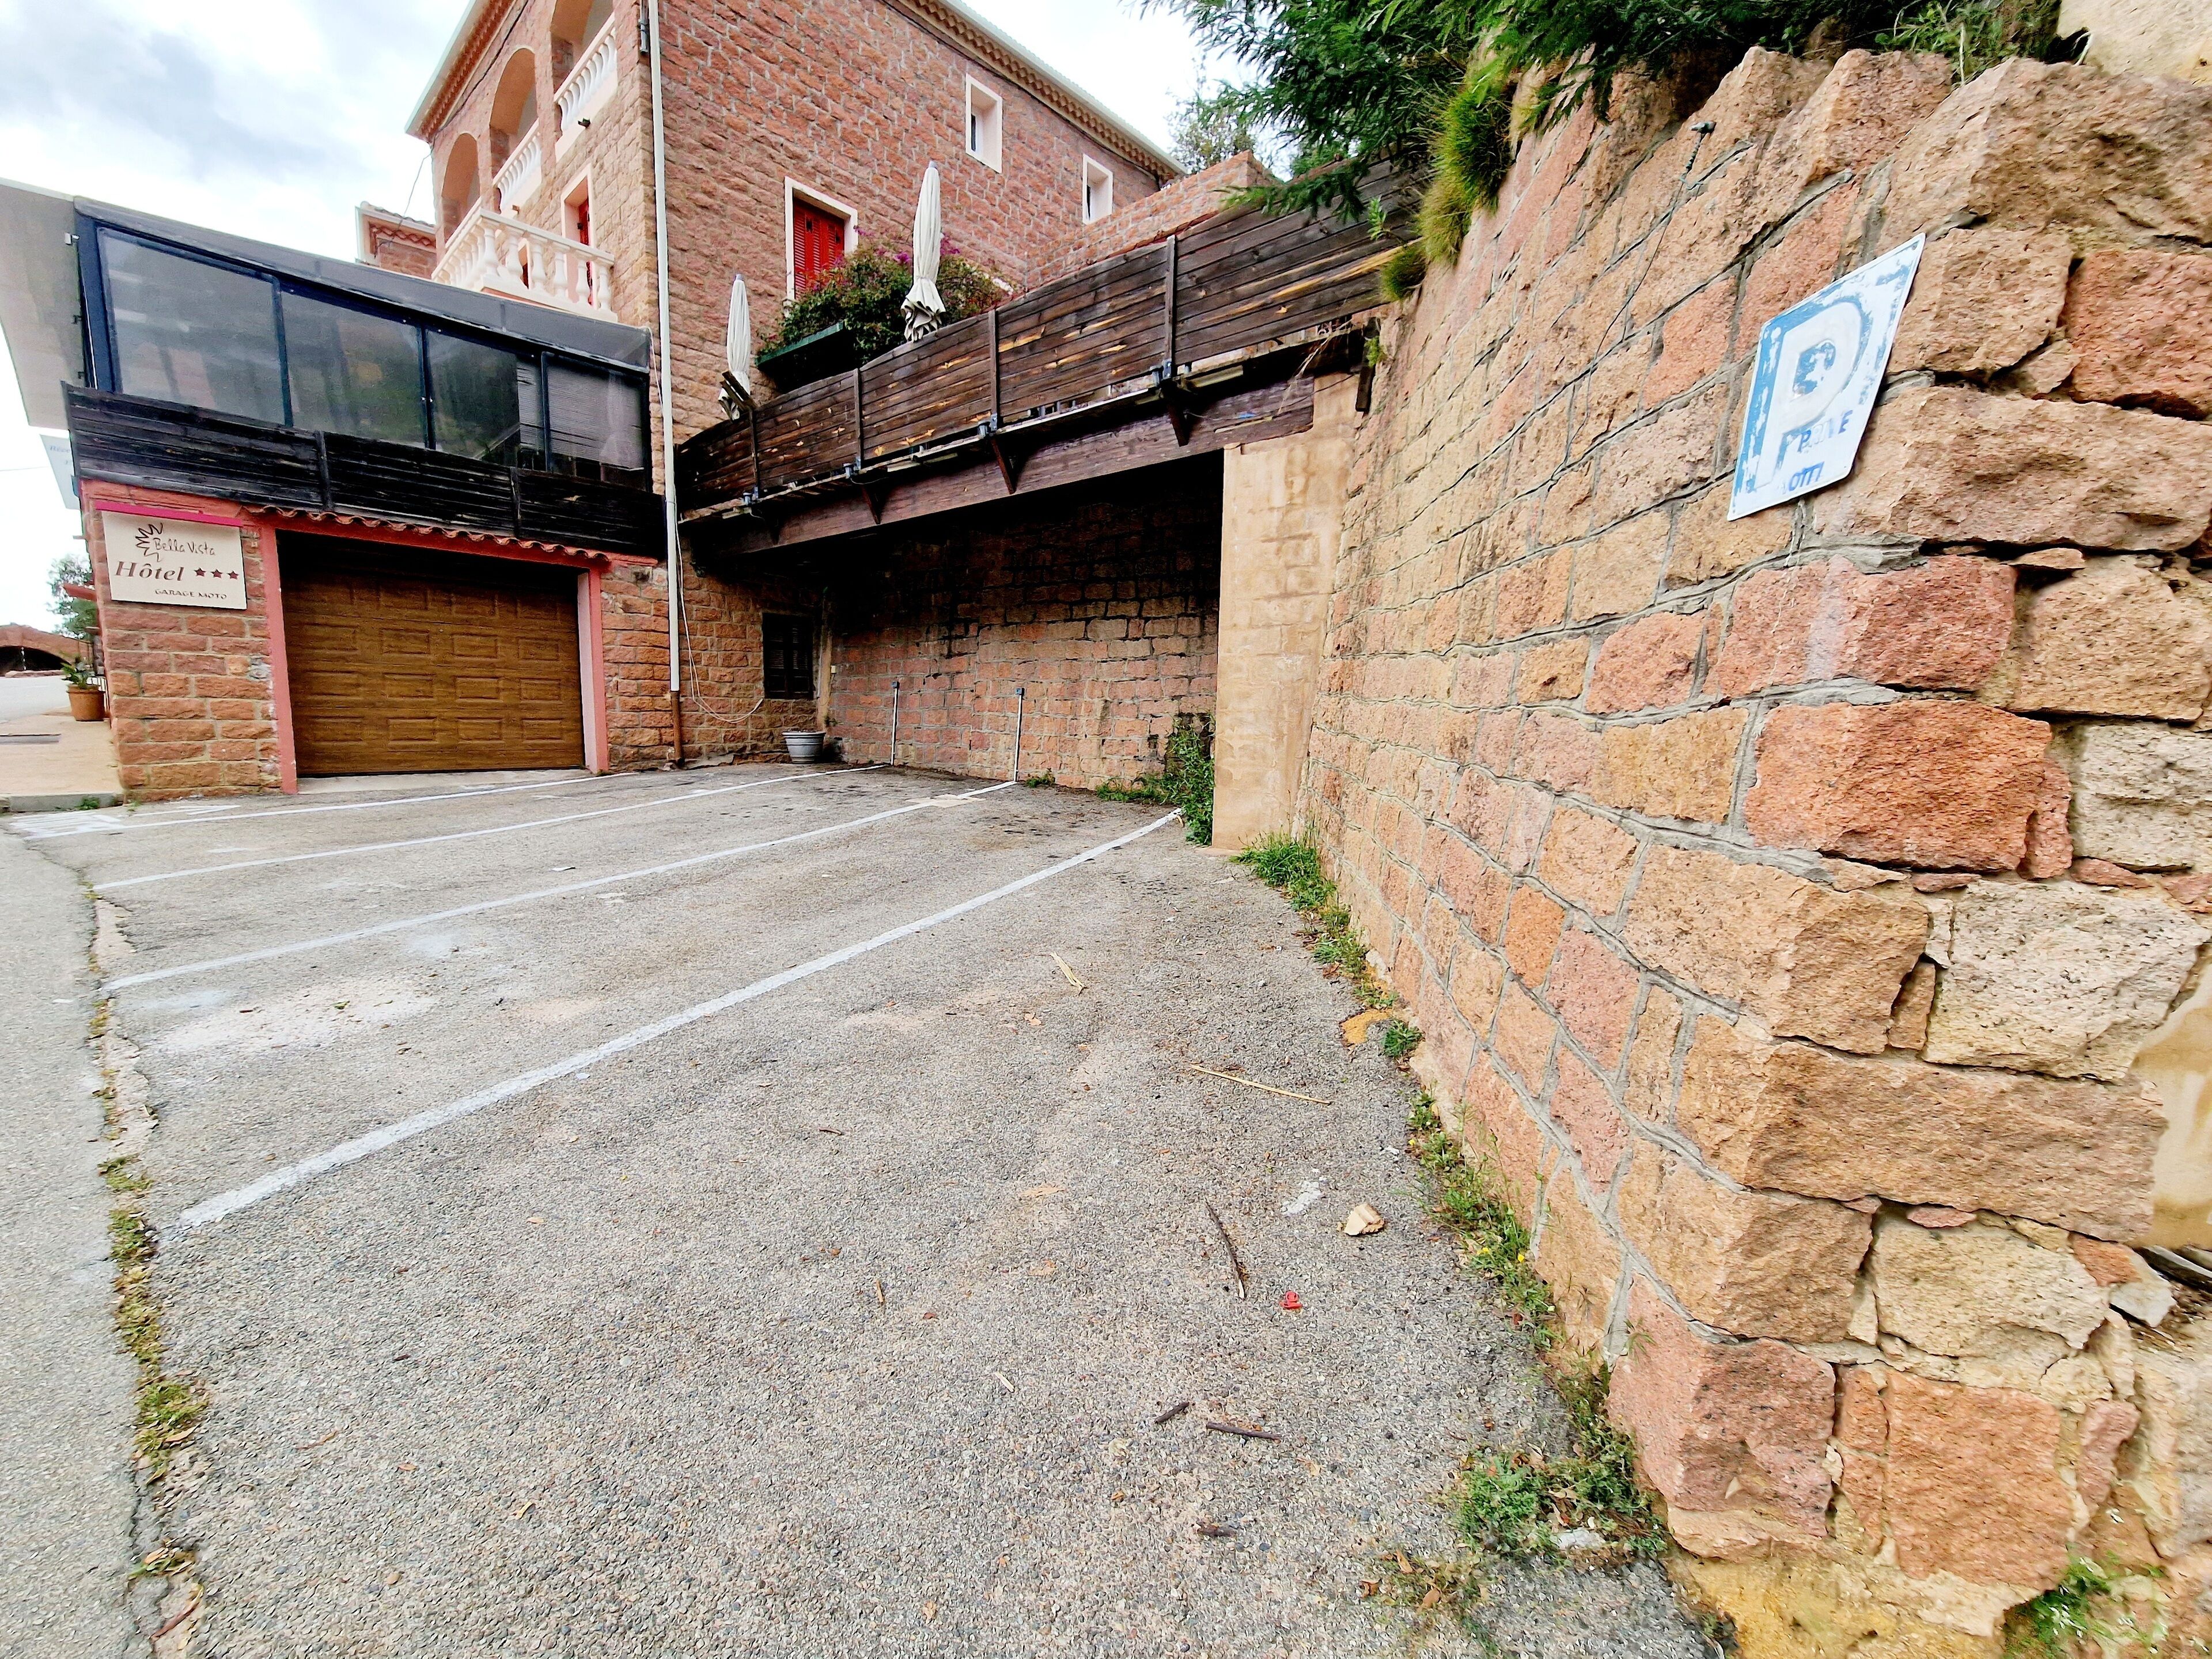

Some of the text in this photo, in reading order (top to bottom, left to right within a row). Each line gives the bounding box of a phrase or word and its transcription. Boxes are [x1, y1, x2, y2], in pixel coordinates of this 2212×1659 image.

[1756, 301, 1862, 489] P
[153, 537, 216, 556] Bella Vista
[115, 561, 184, 581] Hôtel
[154, 589, 194, 597] GARAGE
